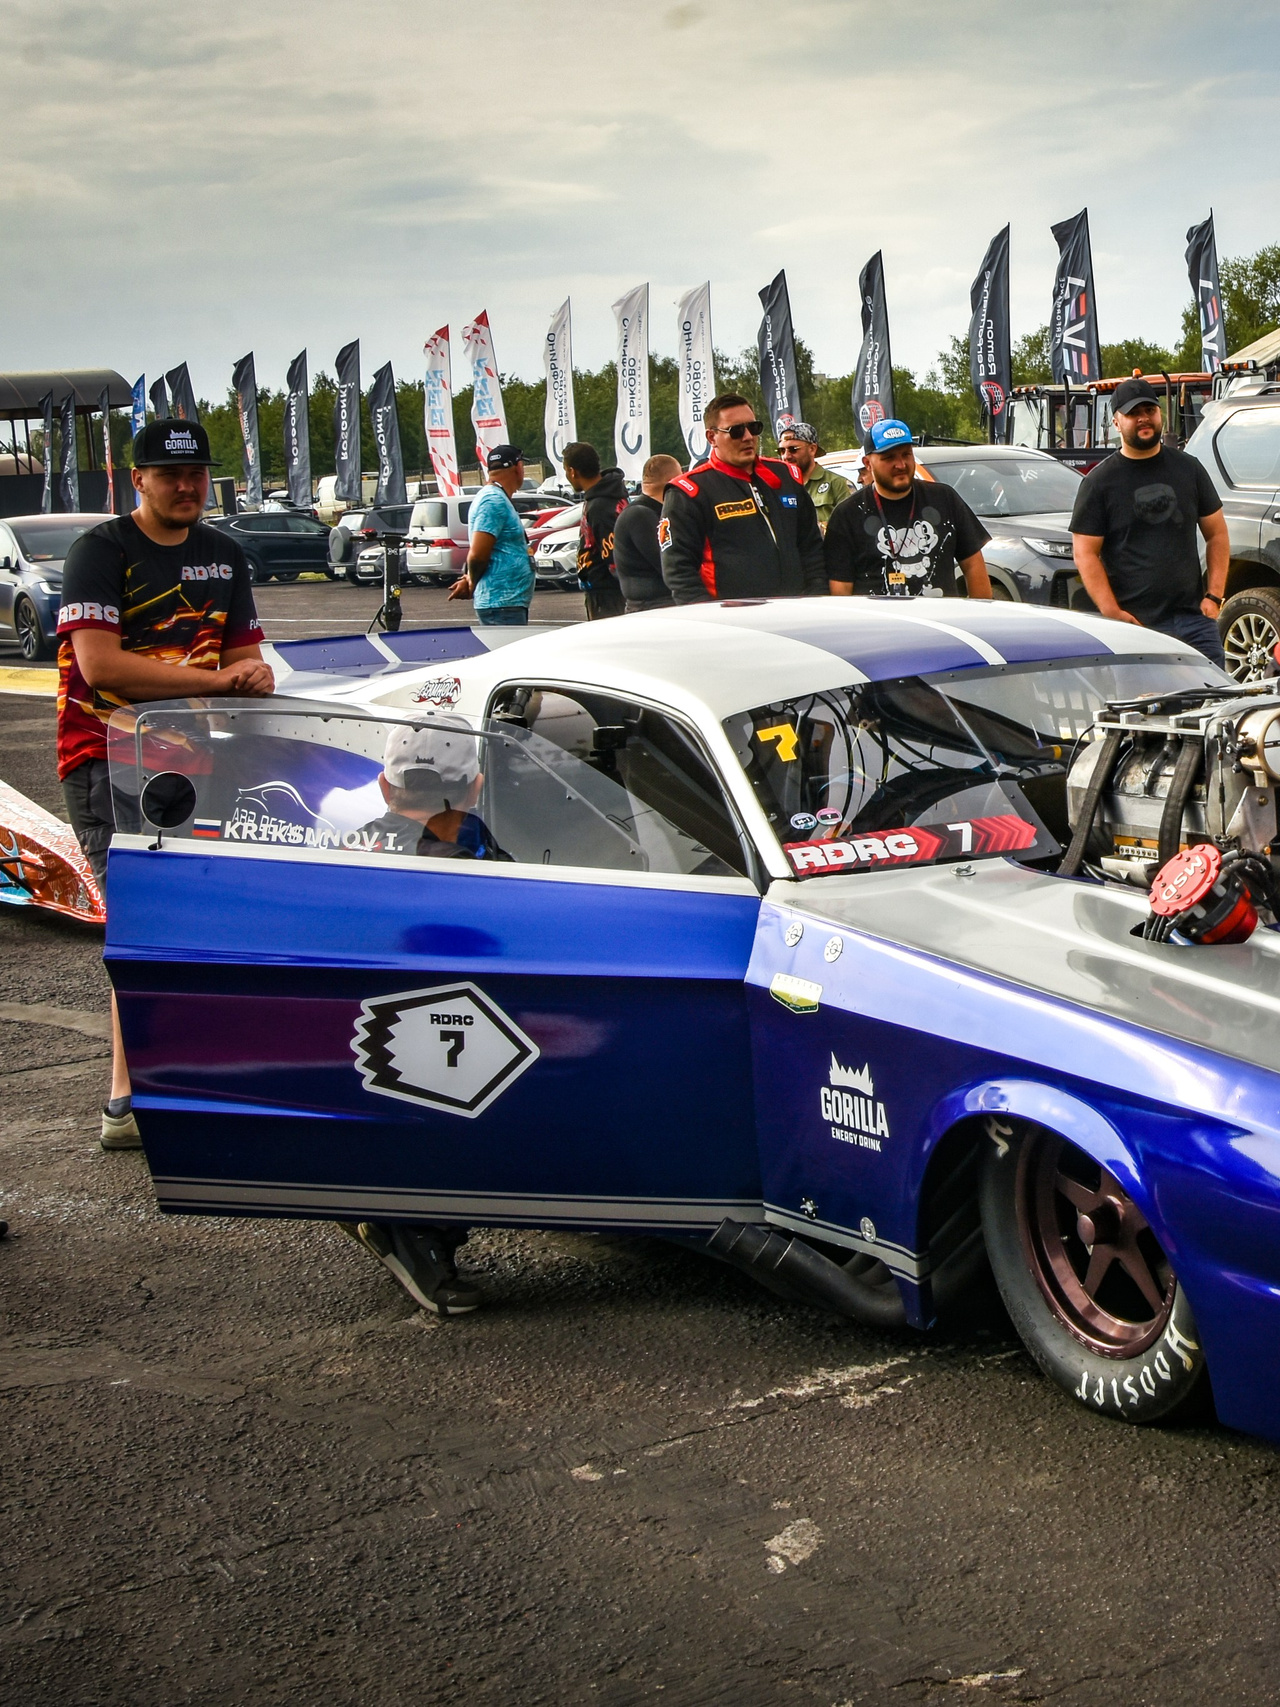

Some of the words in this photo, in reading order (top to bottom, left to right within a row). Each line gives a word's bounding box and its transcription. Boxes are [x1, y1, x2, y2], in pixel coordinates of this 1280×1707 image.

[165, 439, 198, 451] GORILLA
[181, 562, 233, 581] RDRC
[57, 602, 119, 625] RDRC
[1241, 597, 1280, 623] NEXEN
[756, 723, 799, 763] 7
[788, 833, 919, 870] RDRC
[946, 822, 973, 852] 7
[1161, 855, 1204, 901] MSD
[430, 1012, 475, 1027] RDRC
[439, 1030, 466, 1068] 7
[819, 1085, 890, 1139] GORILLA
[830, 1127, 859, 1146] ENERGY
[859, 1135, 882, 1153] DRINK
